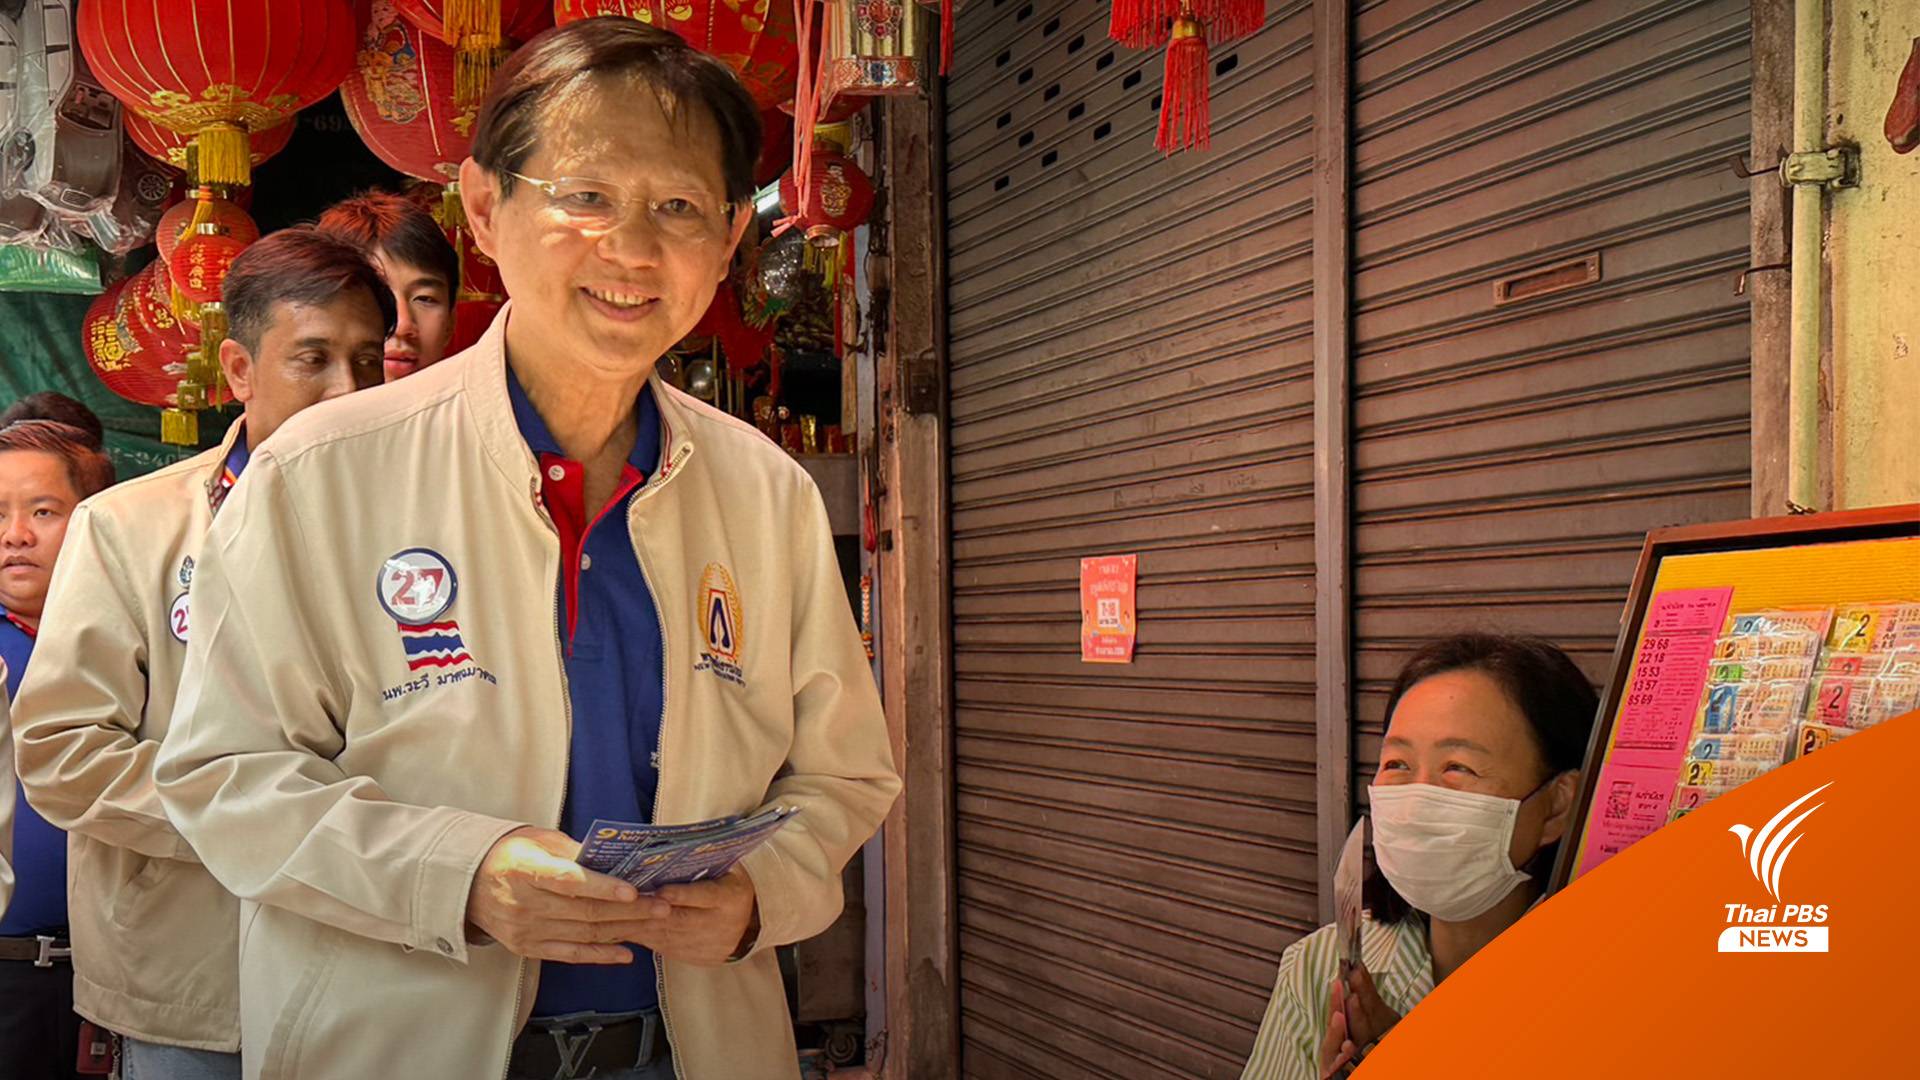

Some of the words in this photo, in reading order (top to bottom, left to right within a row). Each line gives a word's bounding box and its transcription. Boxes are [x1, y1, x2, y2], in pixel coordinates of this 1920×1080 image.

[391, 568, 444, 606] 27
[1856, 614, 1871, 637] 2
[1643, 639, 1656, 650] 29
[1640, 653, 1652, 664] 22
[1637, 667, 1648, 677] 15
[1633, 680, 1644, 691] 13
[1645, 680, 1658, 691] 57
[1829, 686, 1843, 709] 2
[1803, 730, 1816, 755] 2
[1688, 764, 1700, 785] 2
